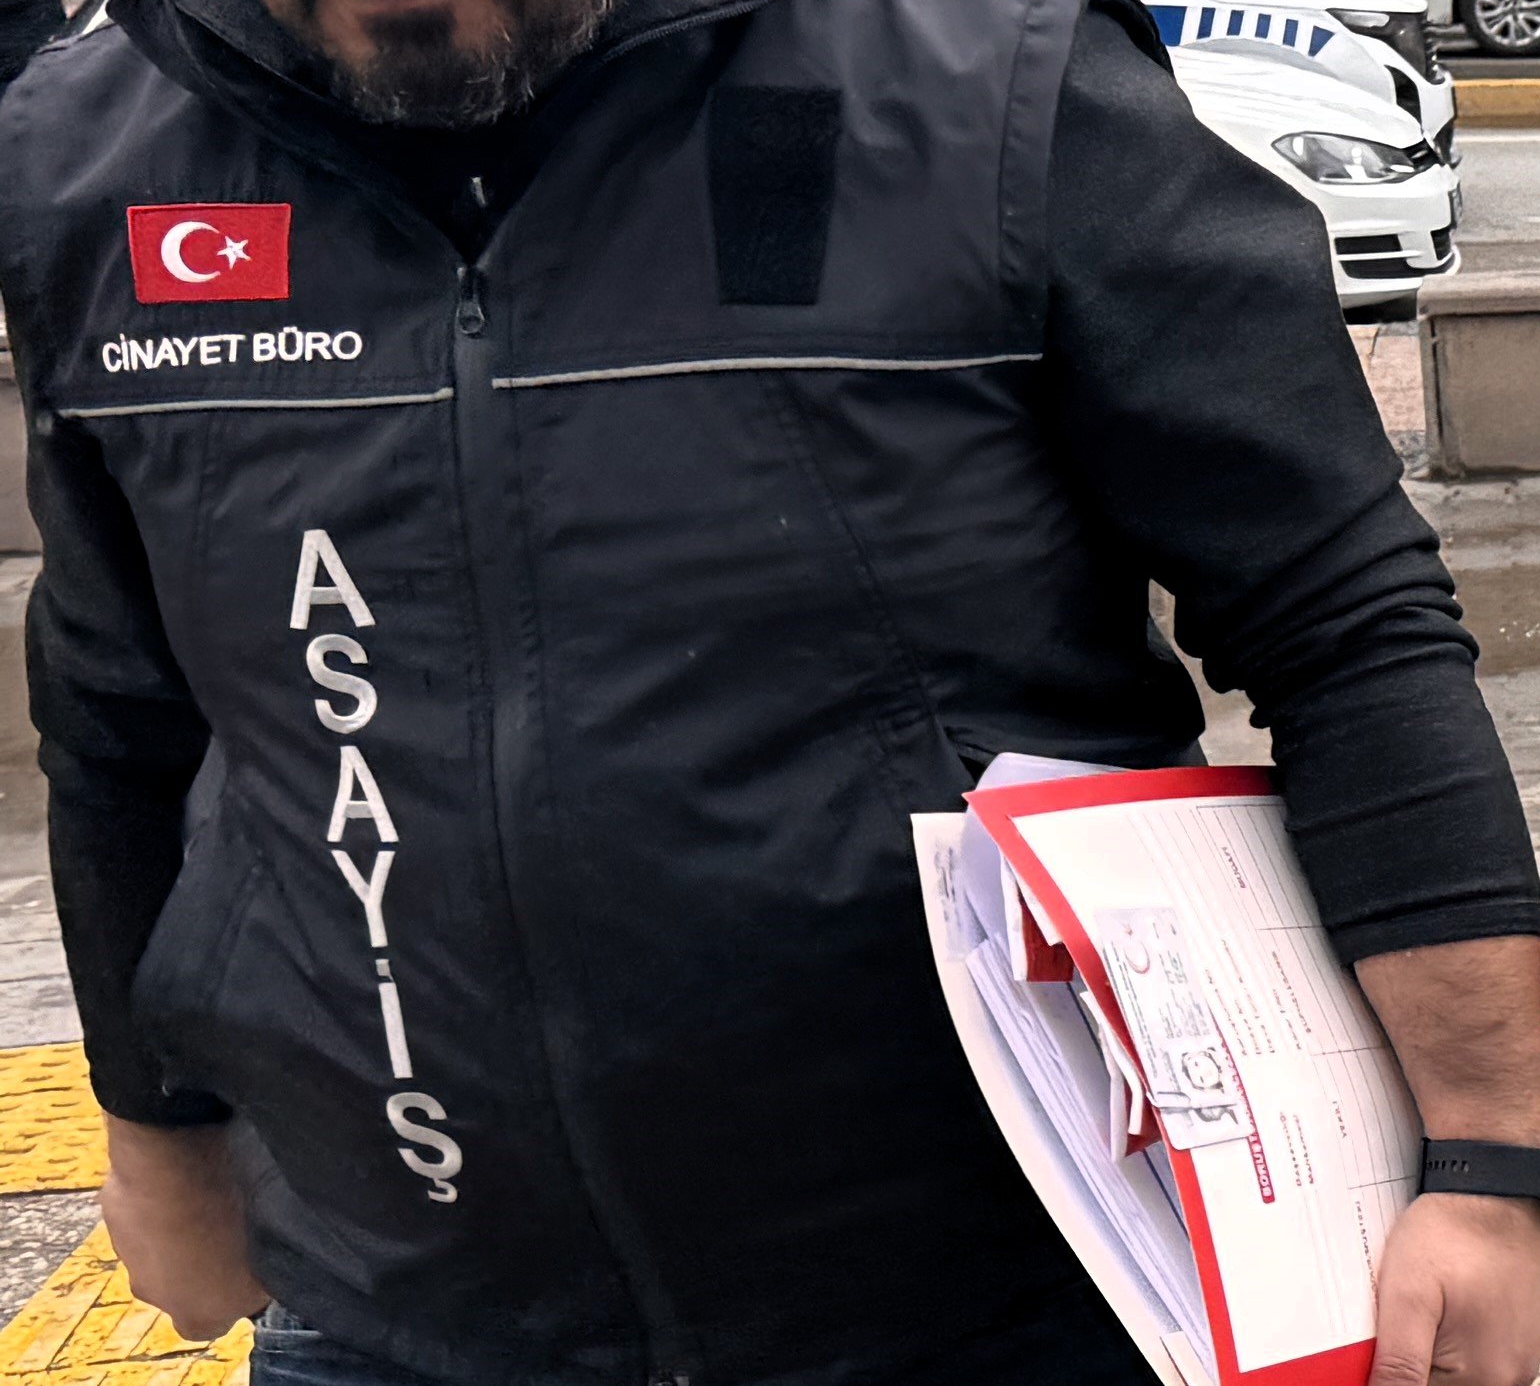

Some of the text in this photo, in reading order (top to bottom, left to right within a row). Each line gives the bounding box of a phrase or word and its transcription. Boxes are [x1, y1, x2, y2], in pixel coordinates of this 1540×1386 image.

[102, 326, 363, 373] CİNAYET BÜRO
[289, 529, 464, 1204] ASAYİŞ
